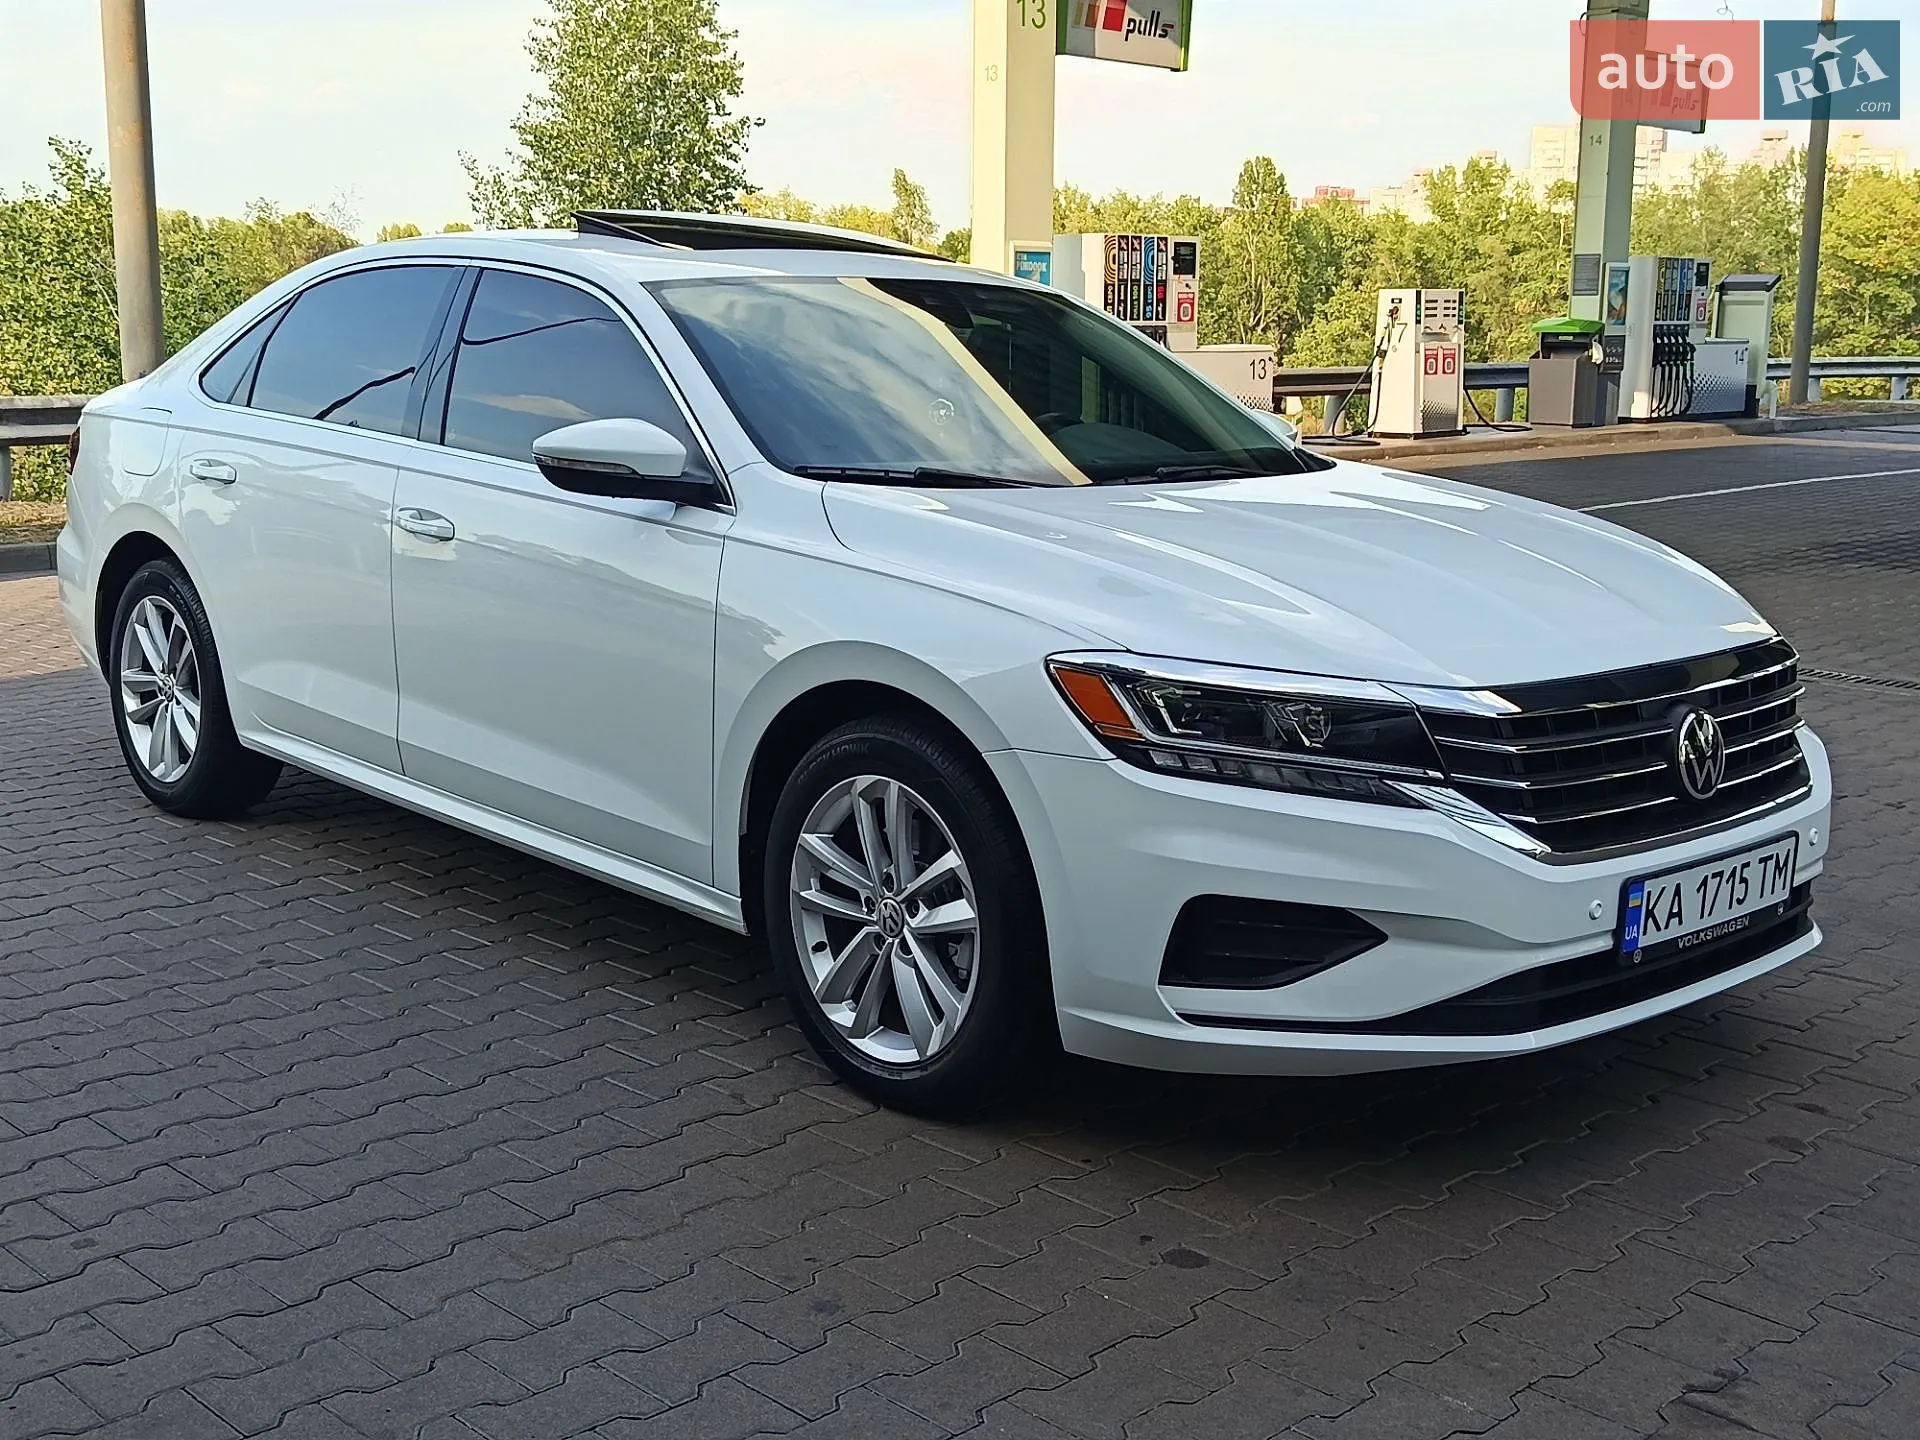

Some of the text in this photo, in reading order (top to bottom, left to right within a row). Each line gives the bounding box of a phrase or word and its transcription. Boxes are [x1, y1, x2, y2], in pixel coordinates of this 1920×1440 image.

[1016, 0, 1046, 29] 13
[1125, 10, 1174, 42] pulls
[985, 64, 998, 82] 13
[1589, 133, 1603, 147] 14
[1396, 322, 1408, 344] 7
[1734, 348, 1746, 365] 14
[1249, 358, 1267, 381] 13
[1642, 847, 1791, 937] KA 1715 TM
[1624, 925, 1638, 940] UA
[1677, 915, 1750, 949] VOLKSWAGEN
